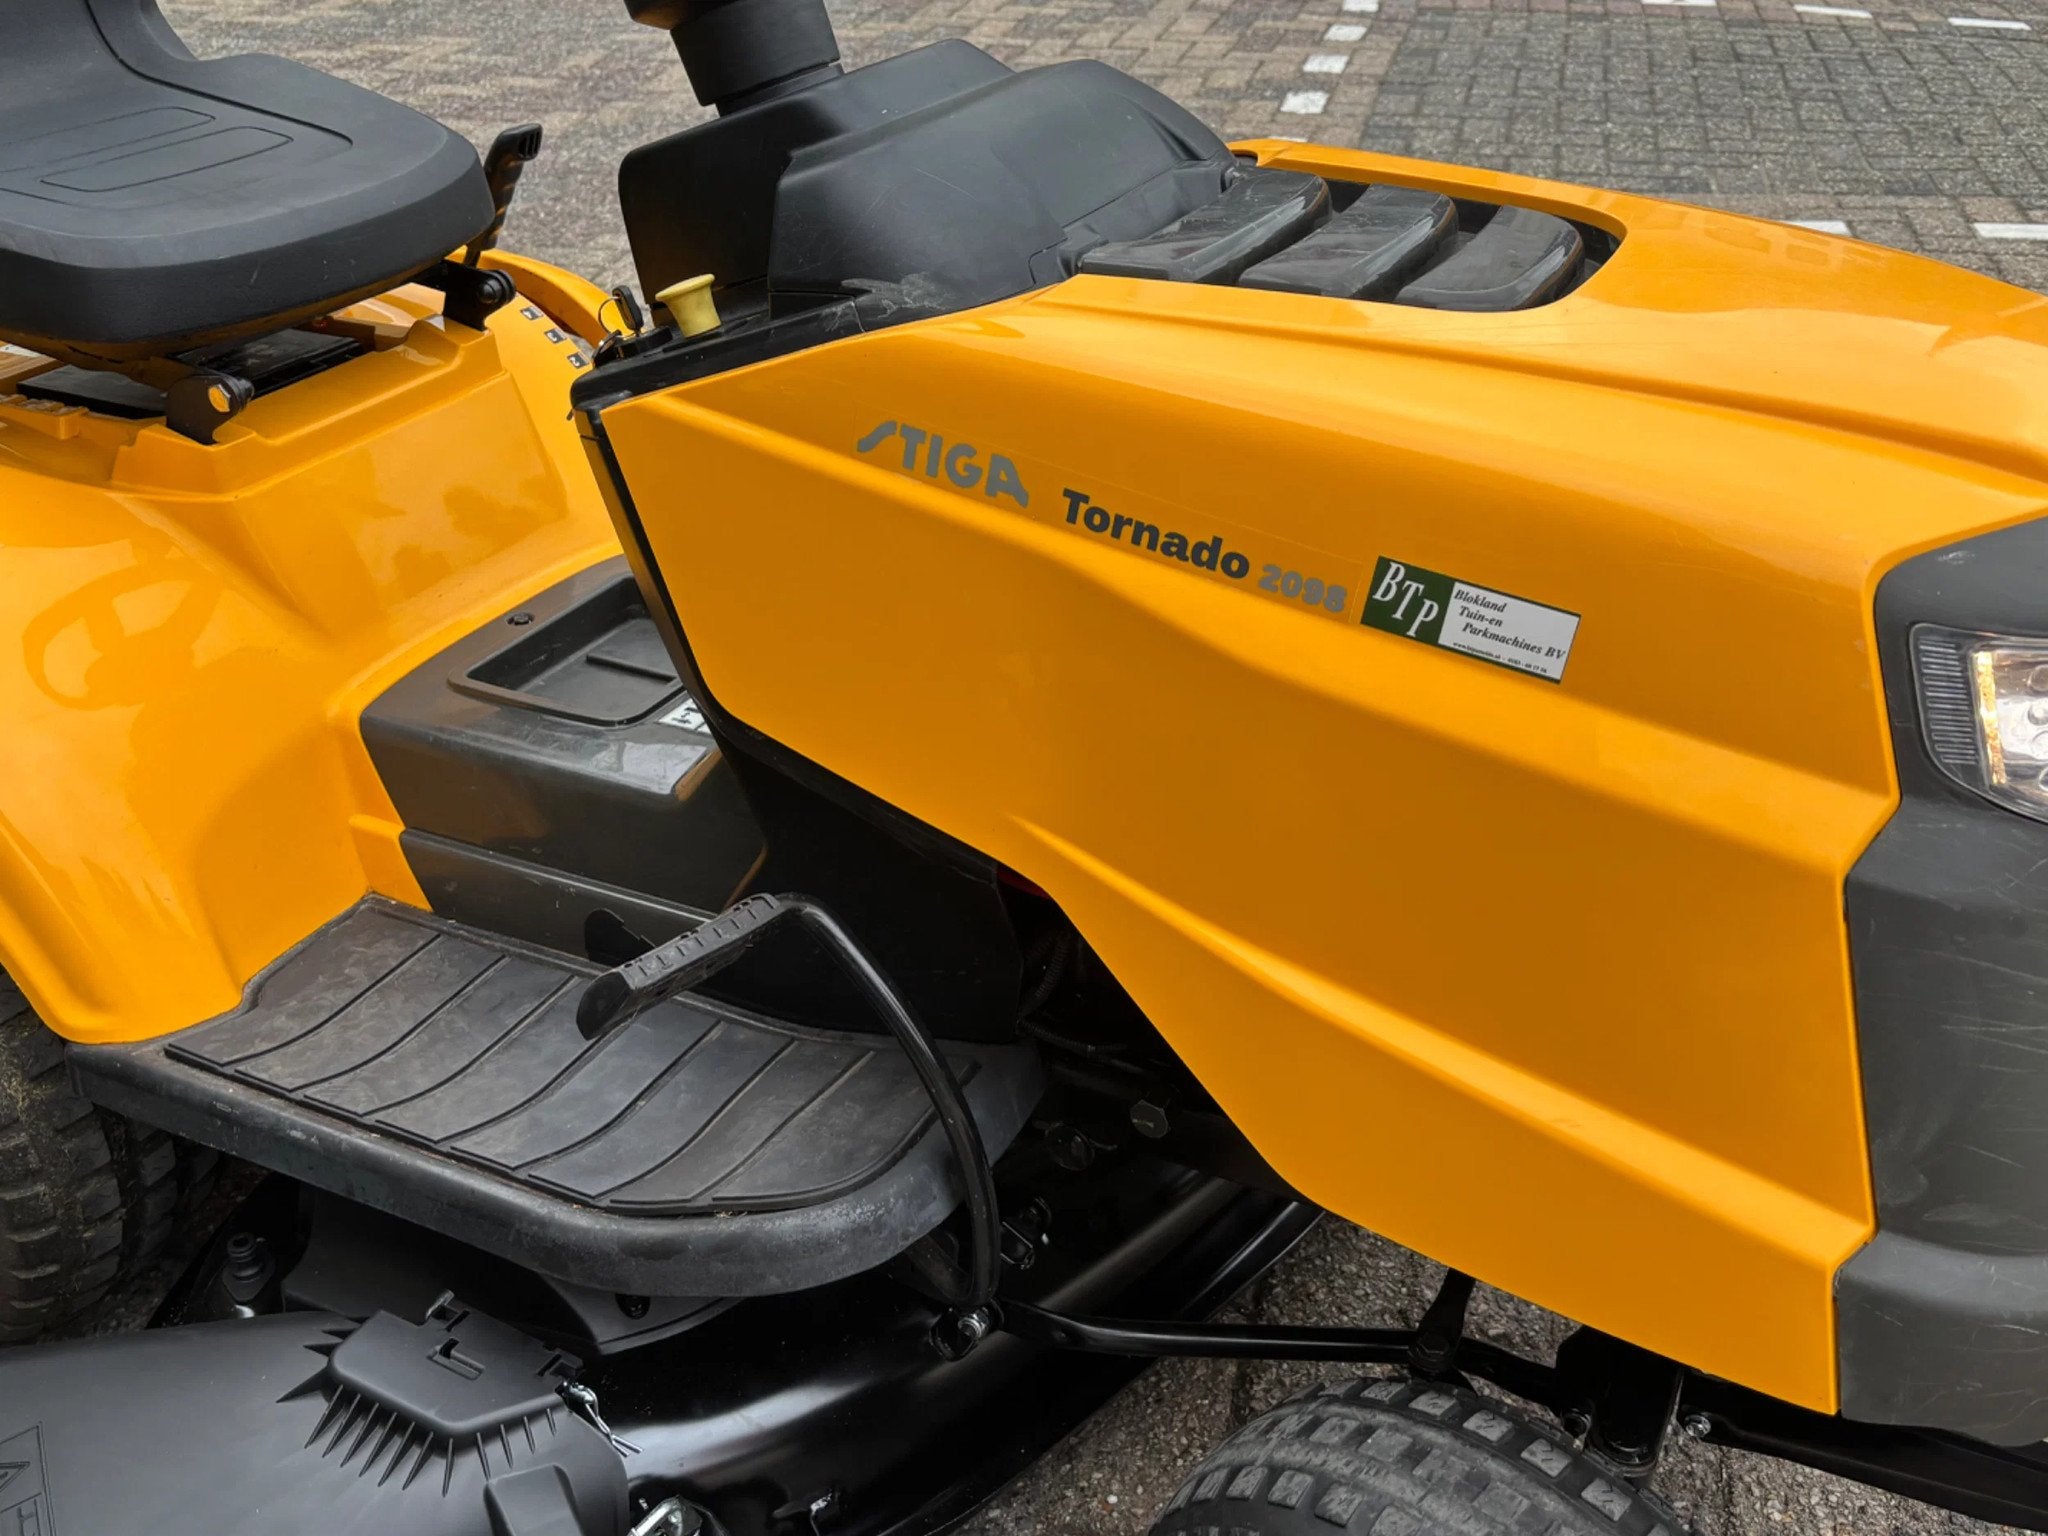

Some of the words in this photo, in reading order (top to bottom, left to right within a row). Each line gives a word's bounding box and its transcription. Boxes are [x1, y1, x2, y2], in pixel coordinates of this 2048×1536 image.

[856, 420, 1030, 509] STIGA
[1062, 488, 1250, 580] Tornado
[1258, 564, 1348, 614] 2098
[1372, 561, 1440, 638] BTP
[1454, 588, 1507, 613] Blokland
[1462, 623, 1542, 655] Parkmachines
[1544, 646, 1567, 660] BV
